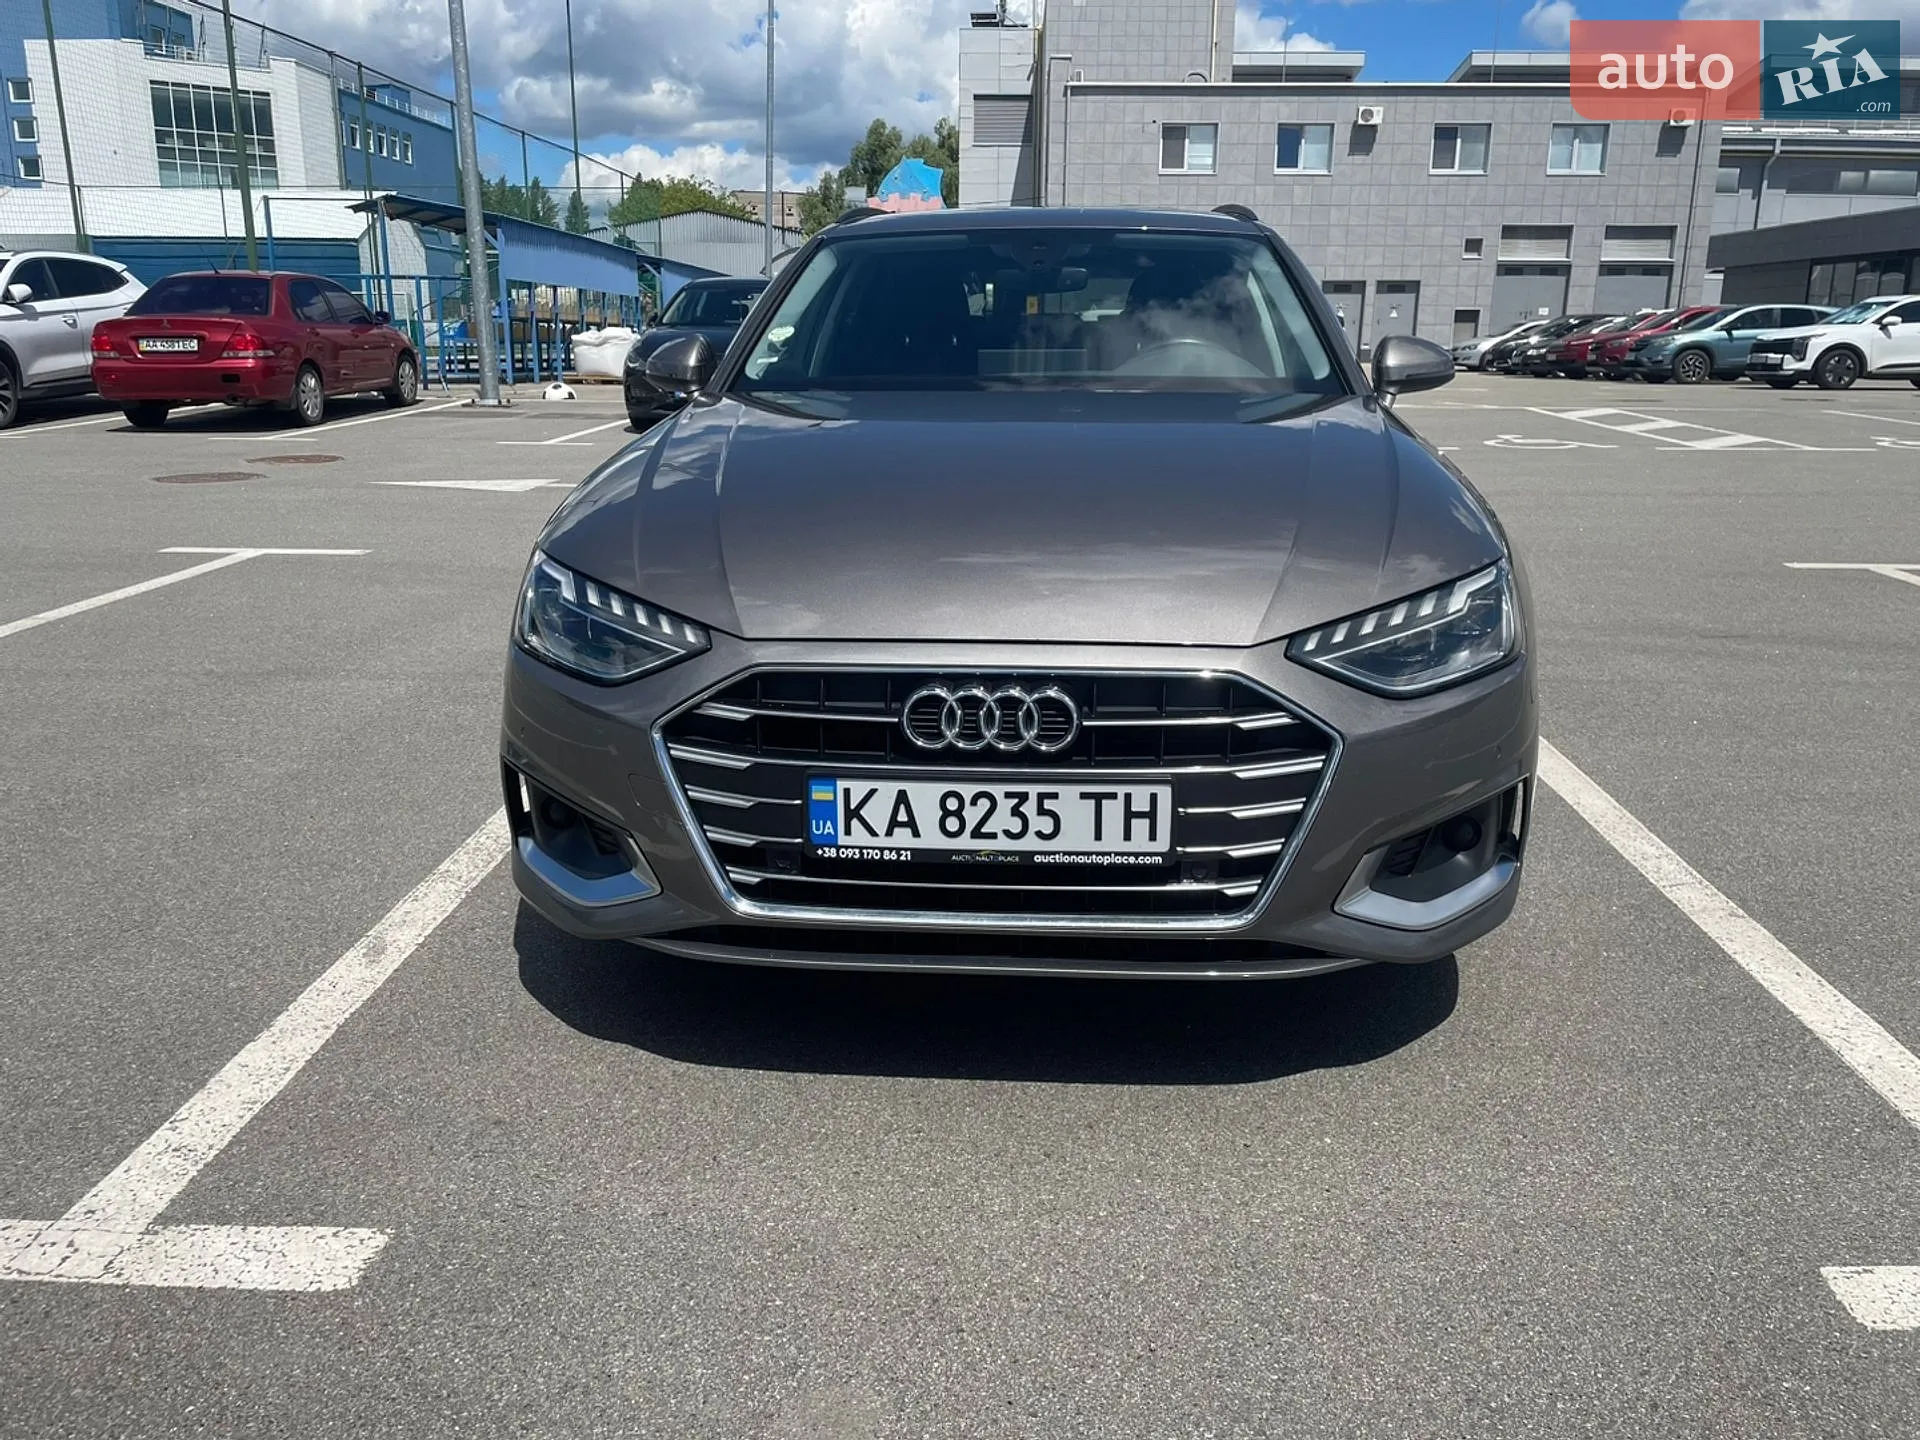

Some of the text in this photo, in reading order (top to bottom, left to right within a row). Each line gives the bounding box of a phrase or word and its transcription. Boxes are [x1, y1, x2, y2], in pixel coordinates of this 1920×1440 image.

[842, 787, 1158, 842] KA 8235 TH
[811, 820, 835, 836] UA
[816, 847, 911, 861] +38 093 170 86 21
[1033, 852, 1163, 865] auctionautoplace.com
